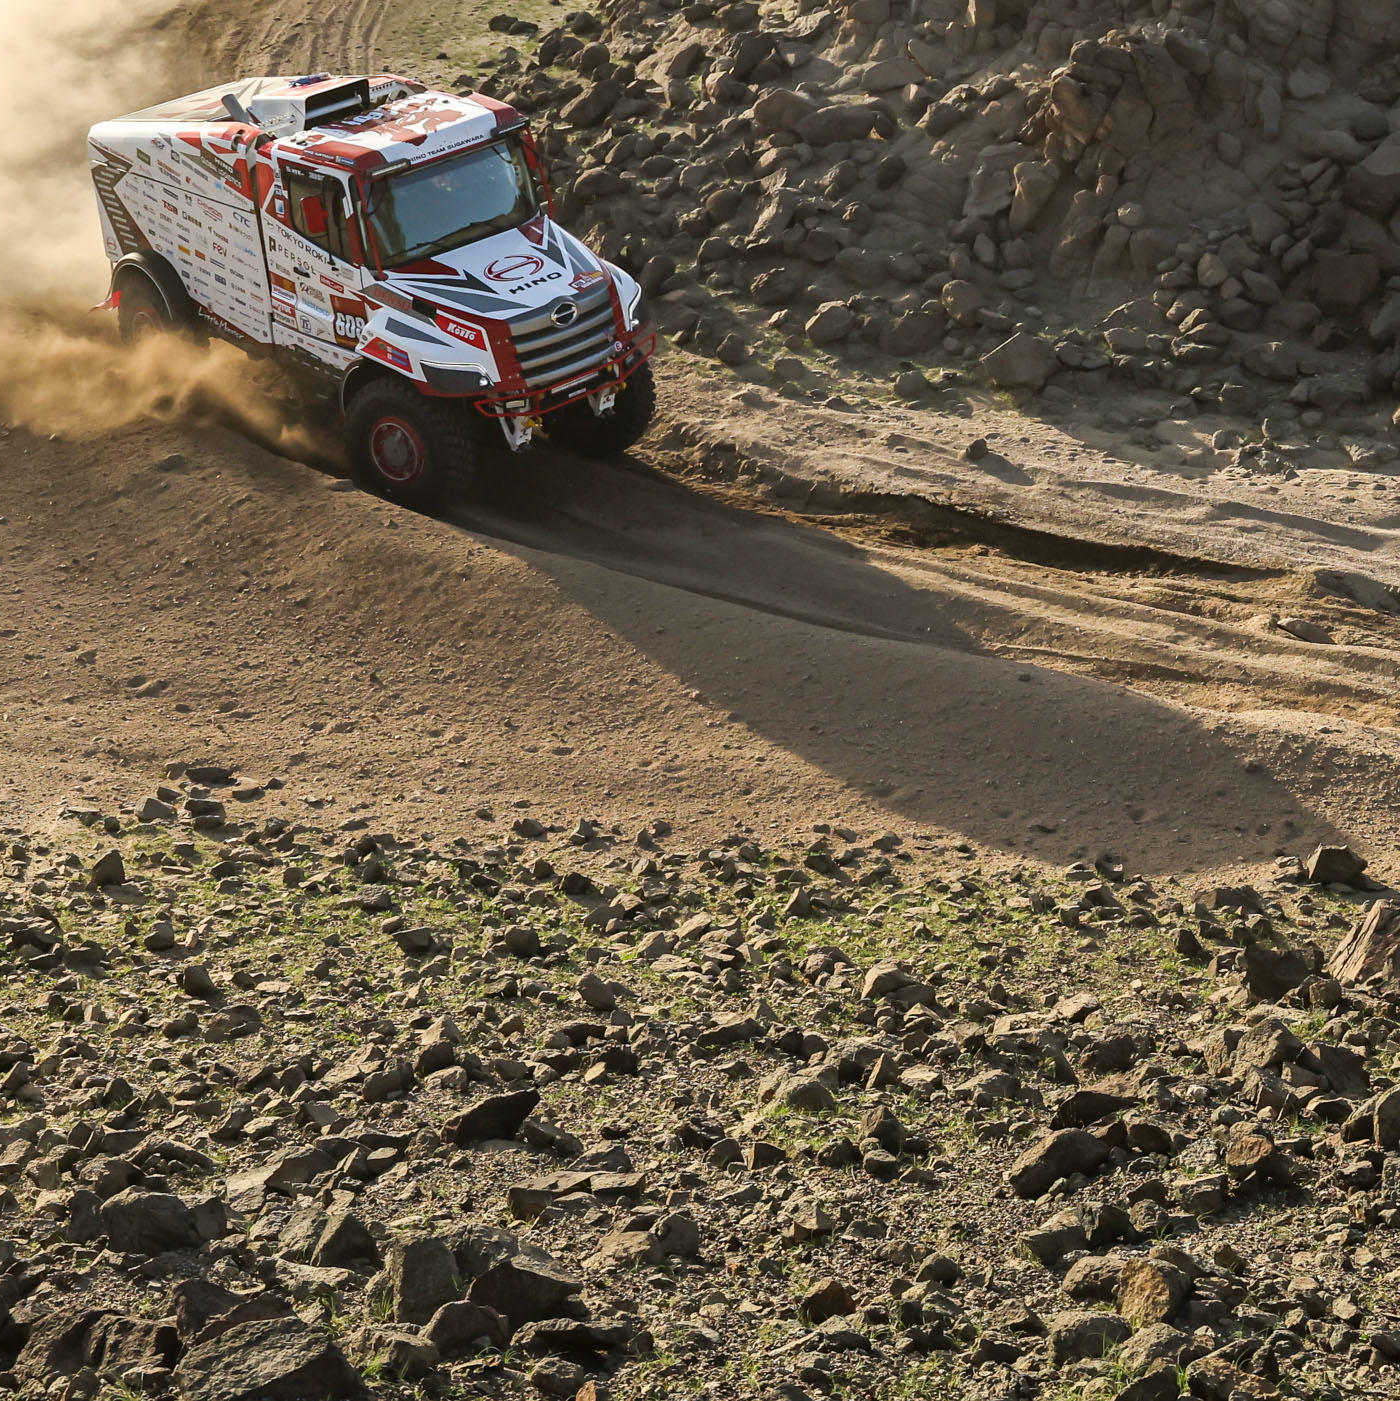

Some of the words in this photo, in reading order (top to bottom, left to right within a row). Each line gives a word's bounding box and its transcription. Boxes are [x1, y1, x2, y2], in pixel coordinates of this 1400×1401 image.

[427, 146, 446, 156] TEAM
[446, 134, 484, 150] SUGAWARA
[214, 156, 234, 174] HINO
[232, 211, 251, 228] CTC
[275, 224, 305, 249] TOKYO
[305, 244, 327, 265] ROKI
[277, 243, 317, 276] PERSOL
[508, 271, 563, 295] HINO
